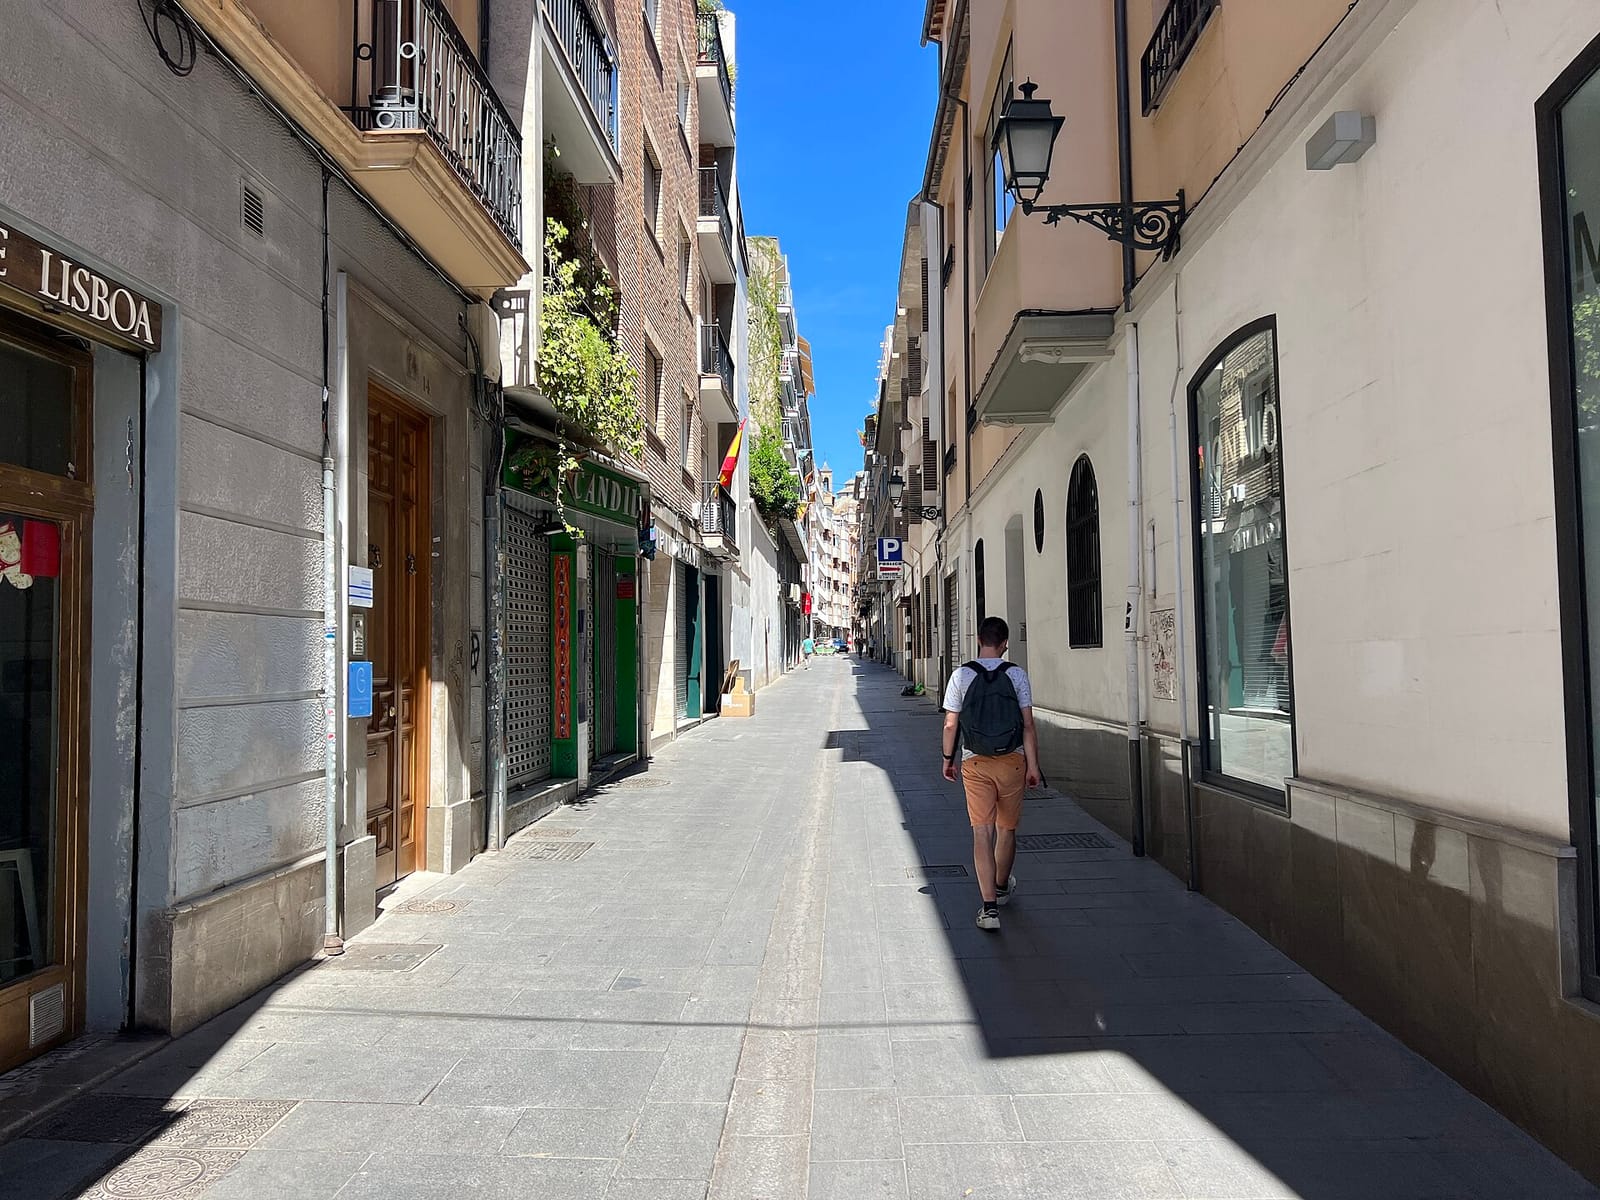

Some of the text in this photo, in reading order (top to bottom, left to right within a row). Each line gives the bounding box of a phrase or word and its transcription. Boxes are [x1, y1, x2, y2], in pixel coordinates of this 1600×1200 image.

[38, 249, 155, 345] LISBOA
[574, 471, 639, 519] CANDIL
[883, 538, 899, 560] P
